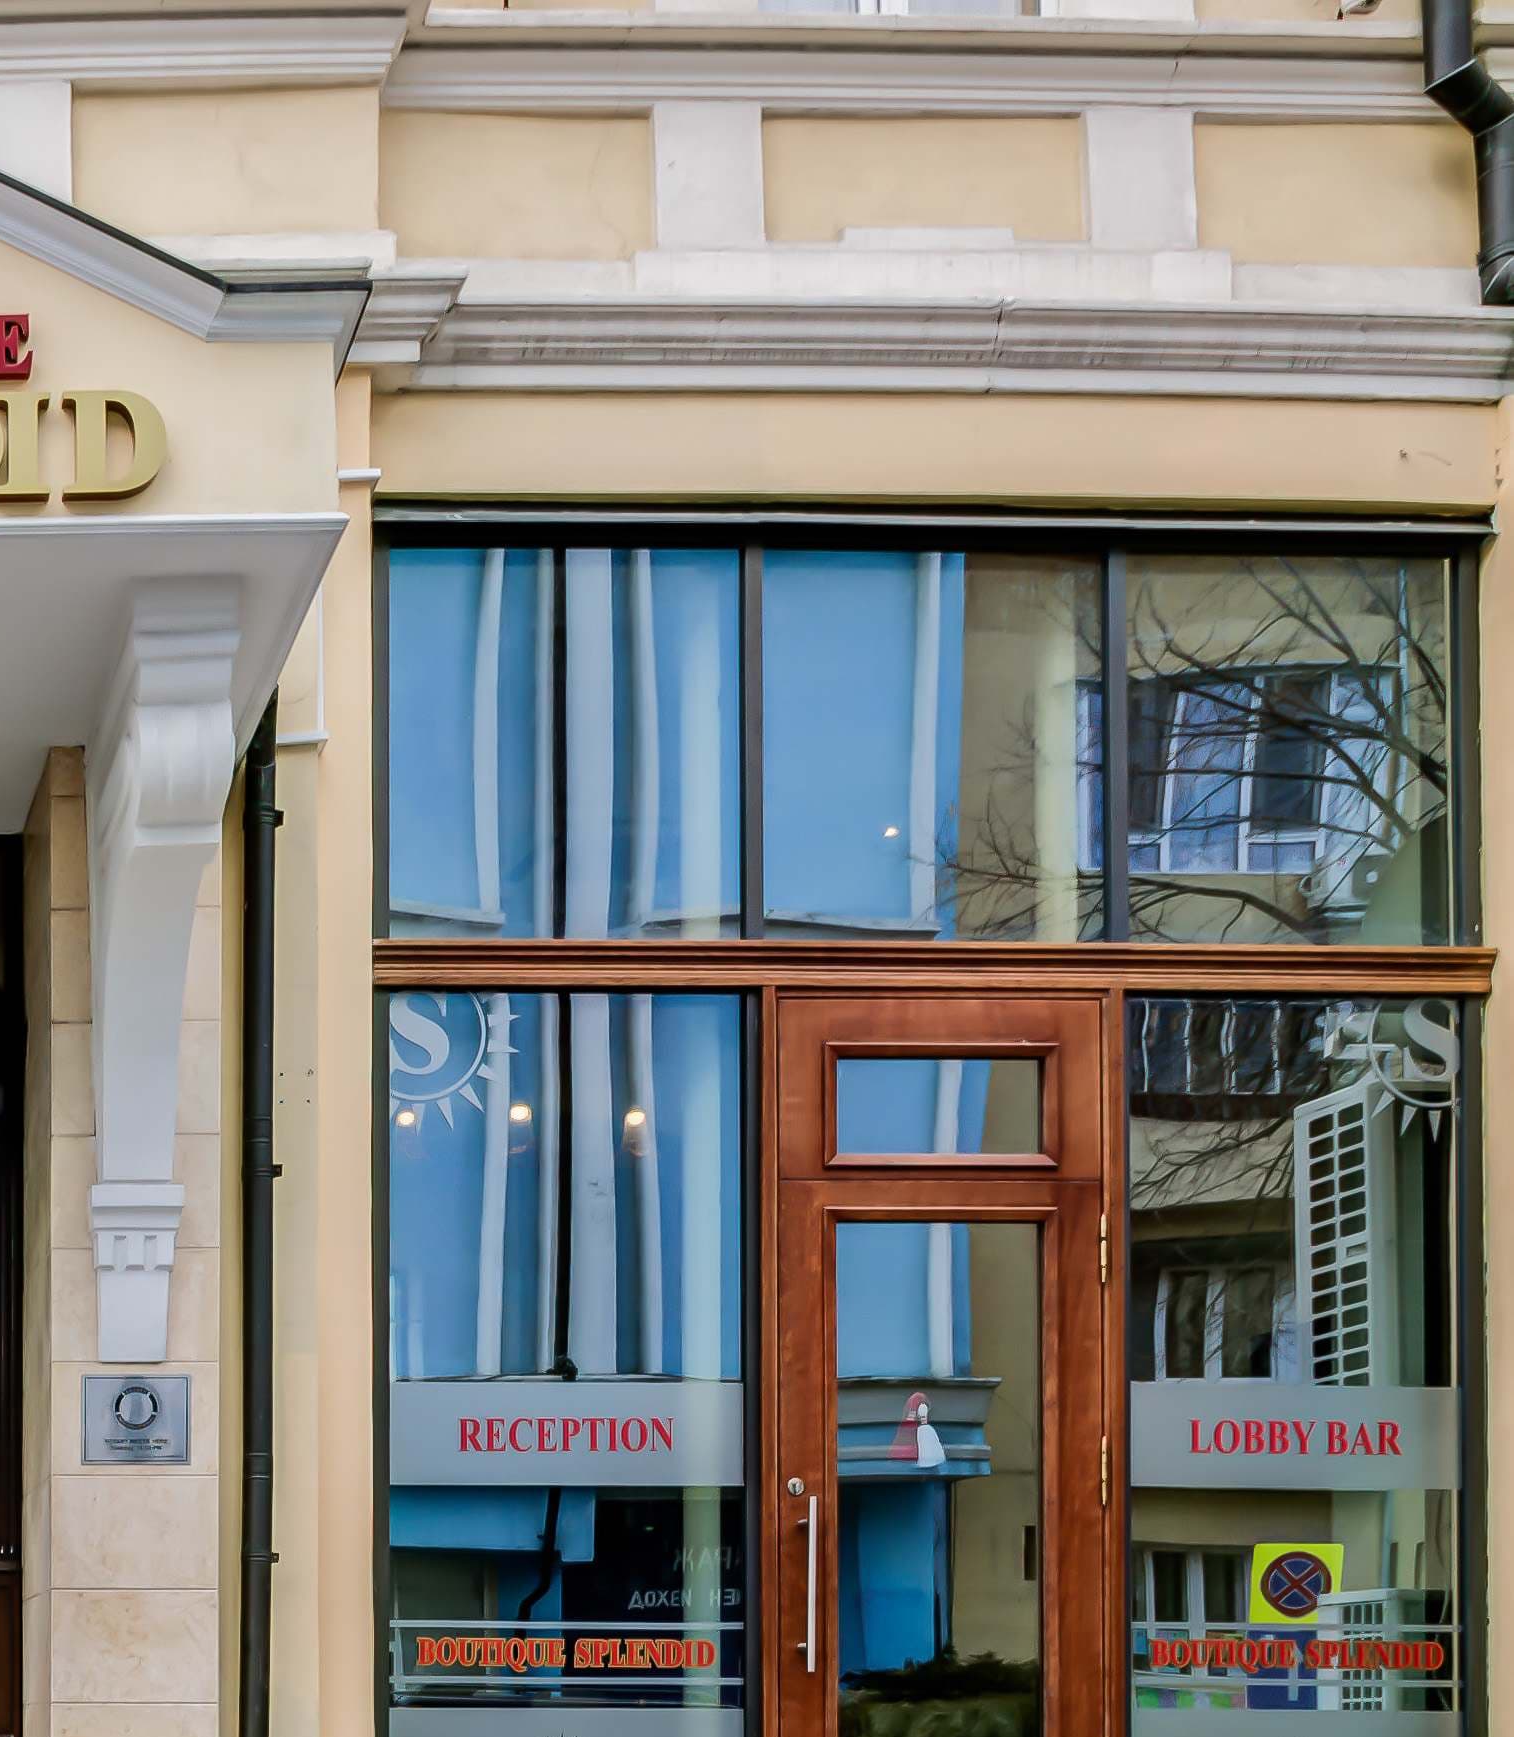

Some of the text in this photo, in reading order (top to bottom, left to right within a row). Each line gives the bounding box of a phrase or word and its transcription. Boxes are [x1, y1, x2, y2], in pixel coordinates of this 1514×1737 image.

[390, 991, 450, 1076] S
[1404, 1000, 1460, 1081] S
[458, 1416, 674, 1453] RECEPTION
[1189, 1419, 1403, 1456] LOBBY BAR
[415, 1637, 717, 1672] BOUTIQUE SPLENDID
[1151, 1638, 1445, 1674] BOUTIQUE SPLENDID
